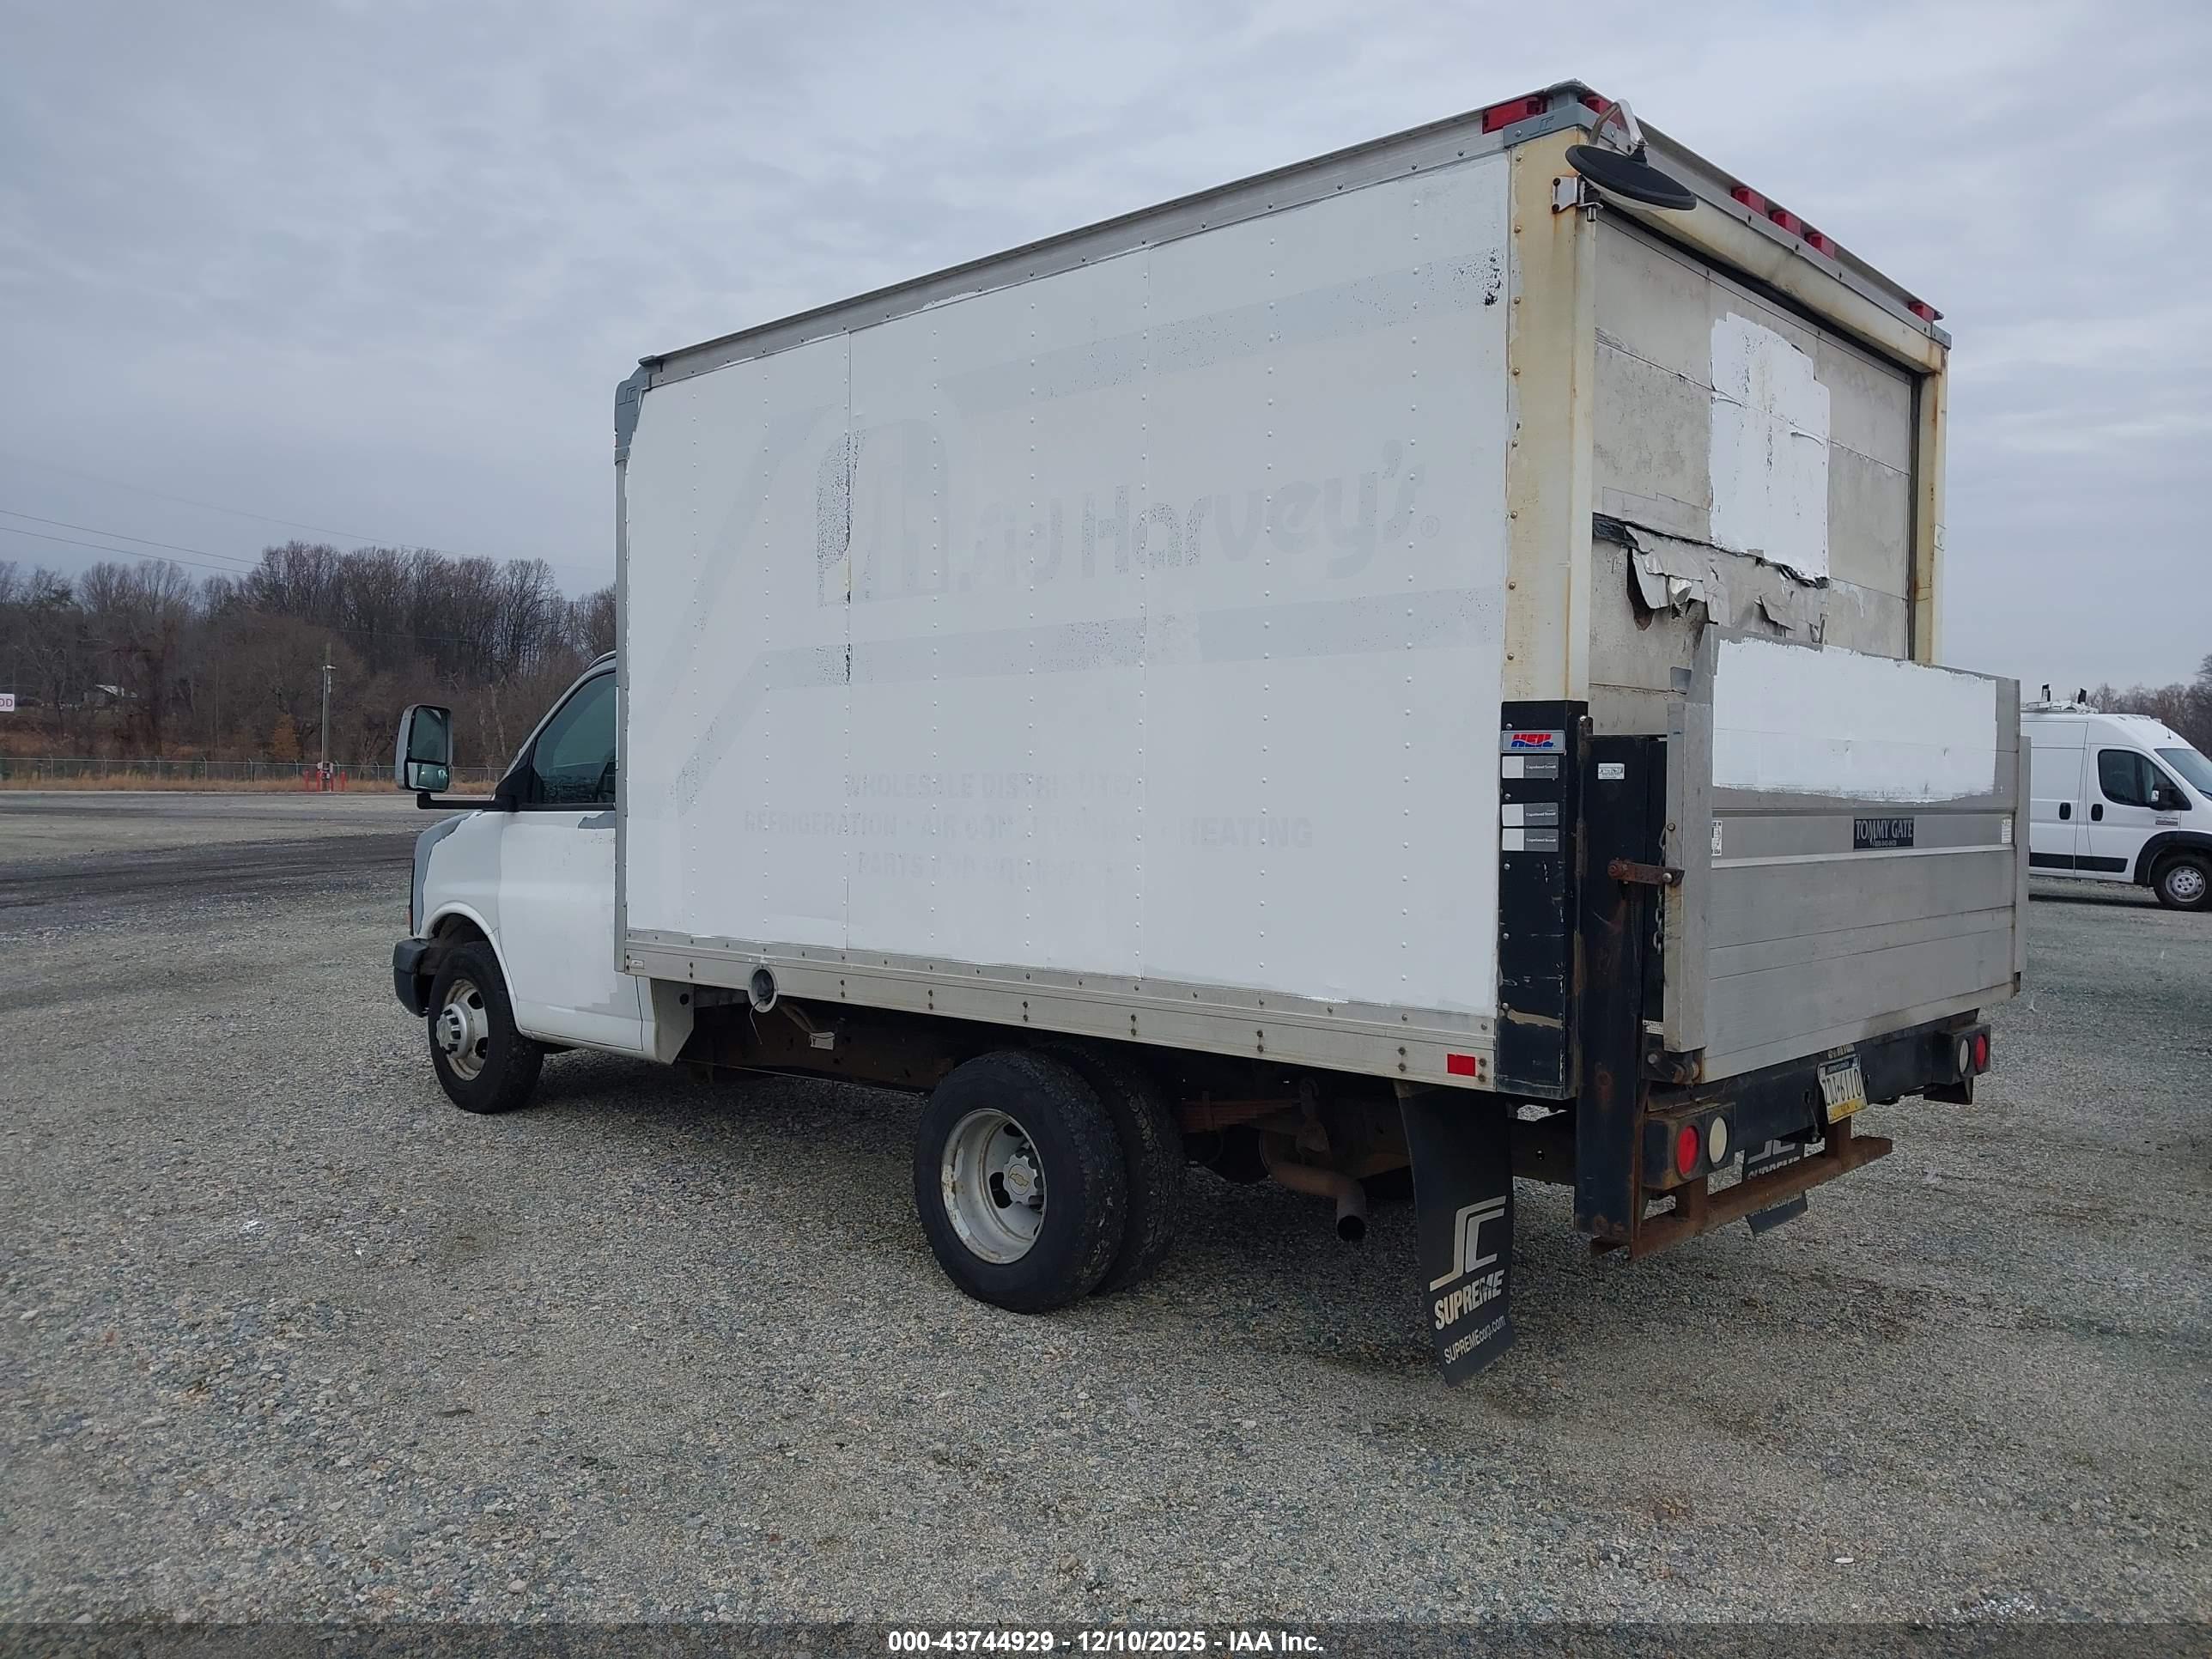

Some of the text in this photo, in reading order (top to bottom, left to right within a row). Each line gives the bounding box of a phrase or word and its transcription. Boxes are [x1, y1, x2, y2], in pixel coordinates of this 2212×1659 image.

[1080, 439, 1426, 580] Harvey's
[845, 773, 976, 799] WHOLESALE
[744, 810, 897, 839] REFRIGERATION
[1176, 816, 1313, 849] HEATING
[1856, 819, 1913, 844] TOMMY GATE
[1434, 1269, 1505, 1331] SUPREME
[1443, 1315, 1506, 1364] SUPREMEcorp.com
